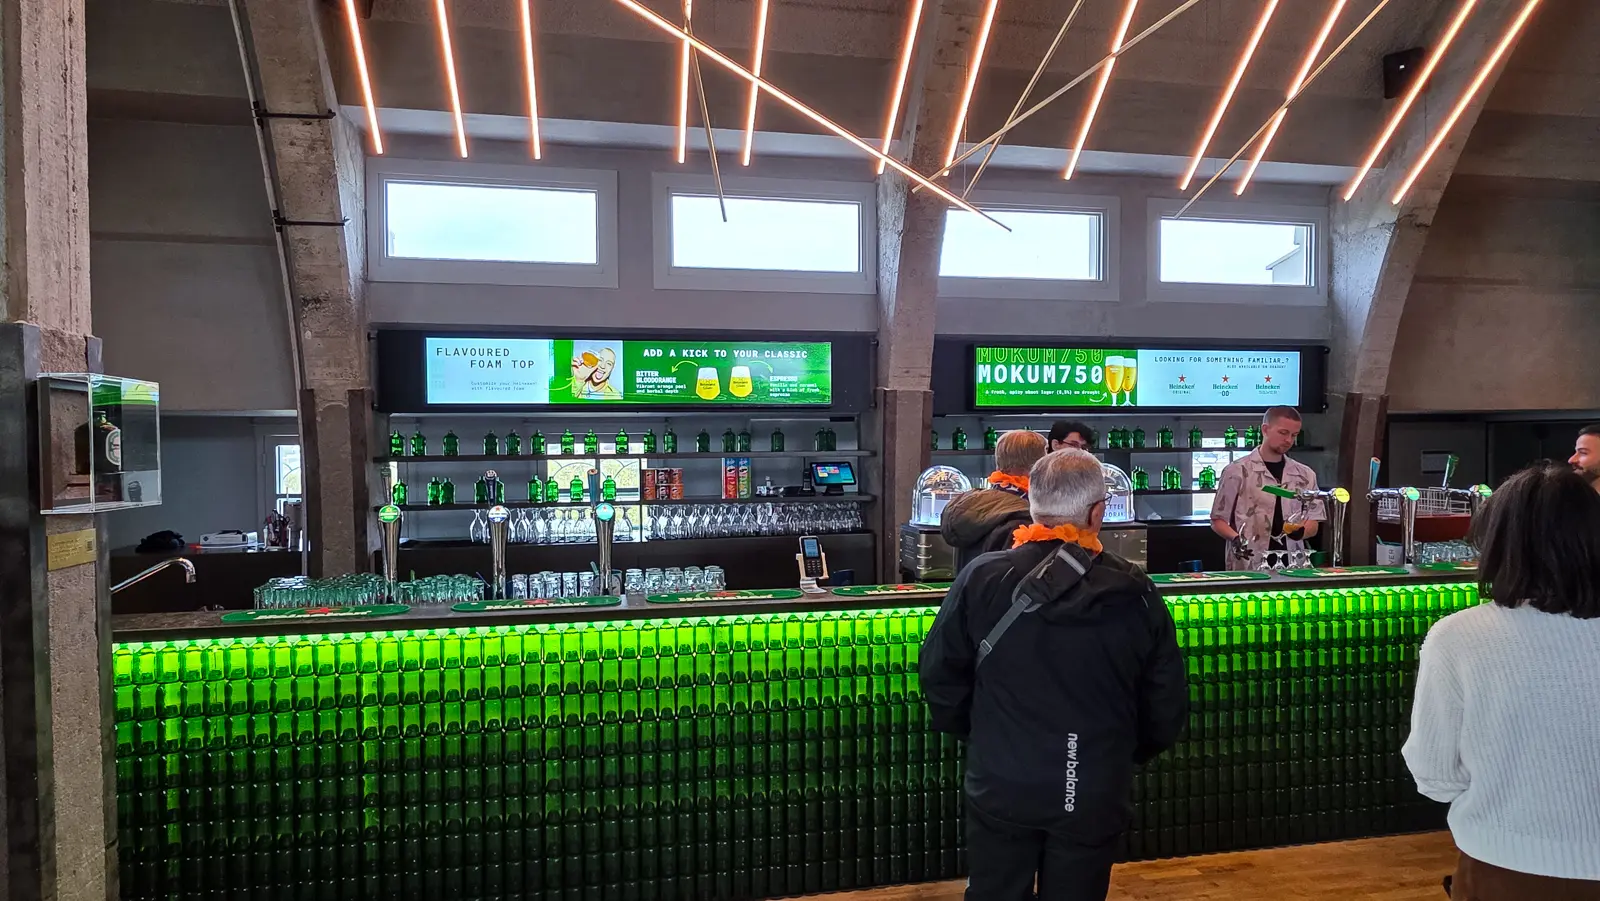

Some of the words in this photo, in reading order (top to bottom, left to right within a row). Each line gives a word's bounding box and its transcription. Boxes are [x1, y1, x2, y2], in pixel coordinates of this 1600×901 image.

[436, 347, 510, 357] FLAVOURED
[643, 349, 663, 357] ADD
[669, 349, 676, 357] A
[682, 349, 708, 358] KICK
[714, 349, 727, 358] TO
[733, 349, 759, 358] YOUR
[764, 350, 808, 359] CLASSIC
[470, 359, 502, 369] FOAM
[511, 360, 535, 370] TOP
[978, 364, 1103, 384] MOKUM750
[1067, 732, 1078, 760] new
[1064, 760, 1080, 812] balance
